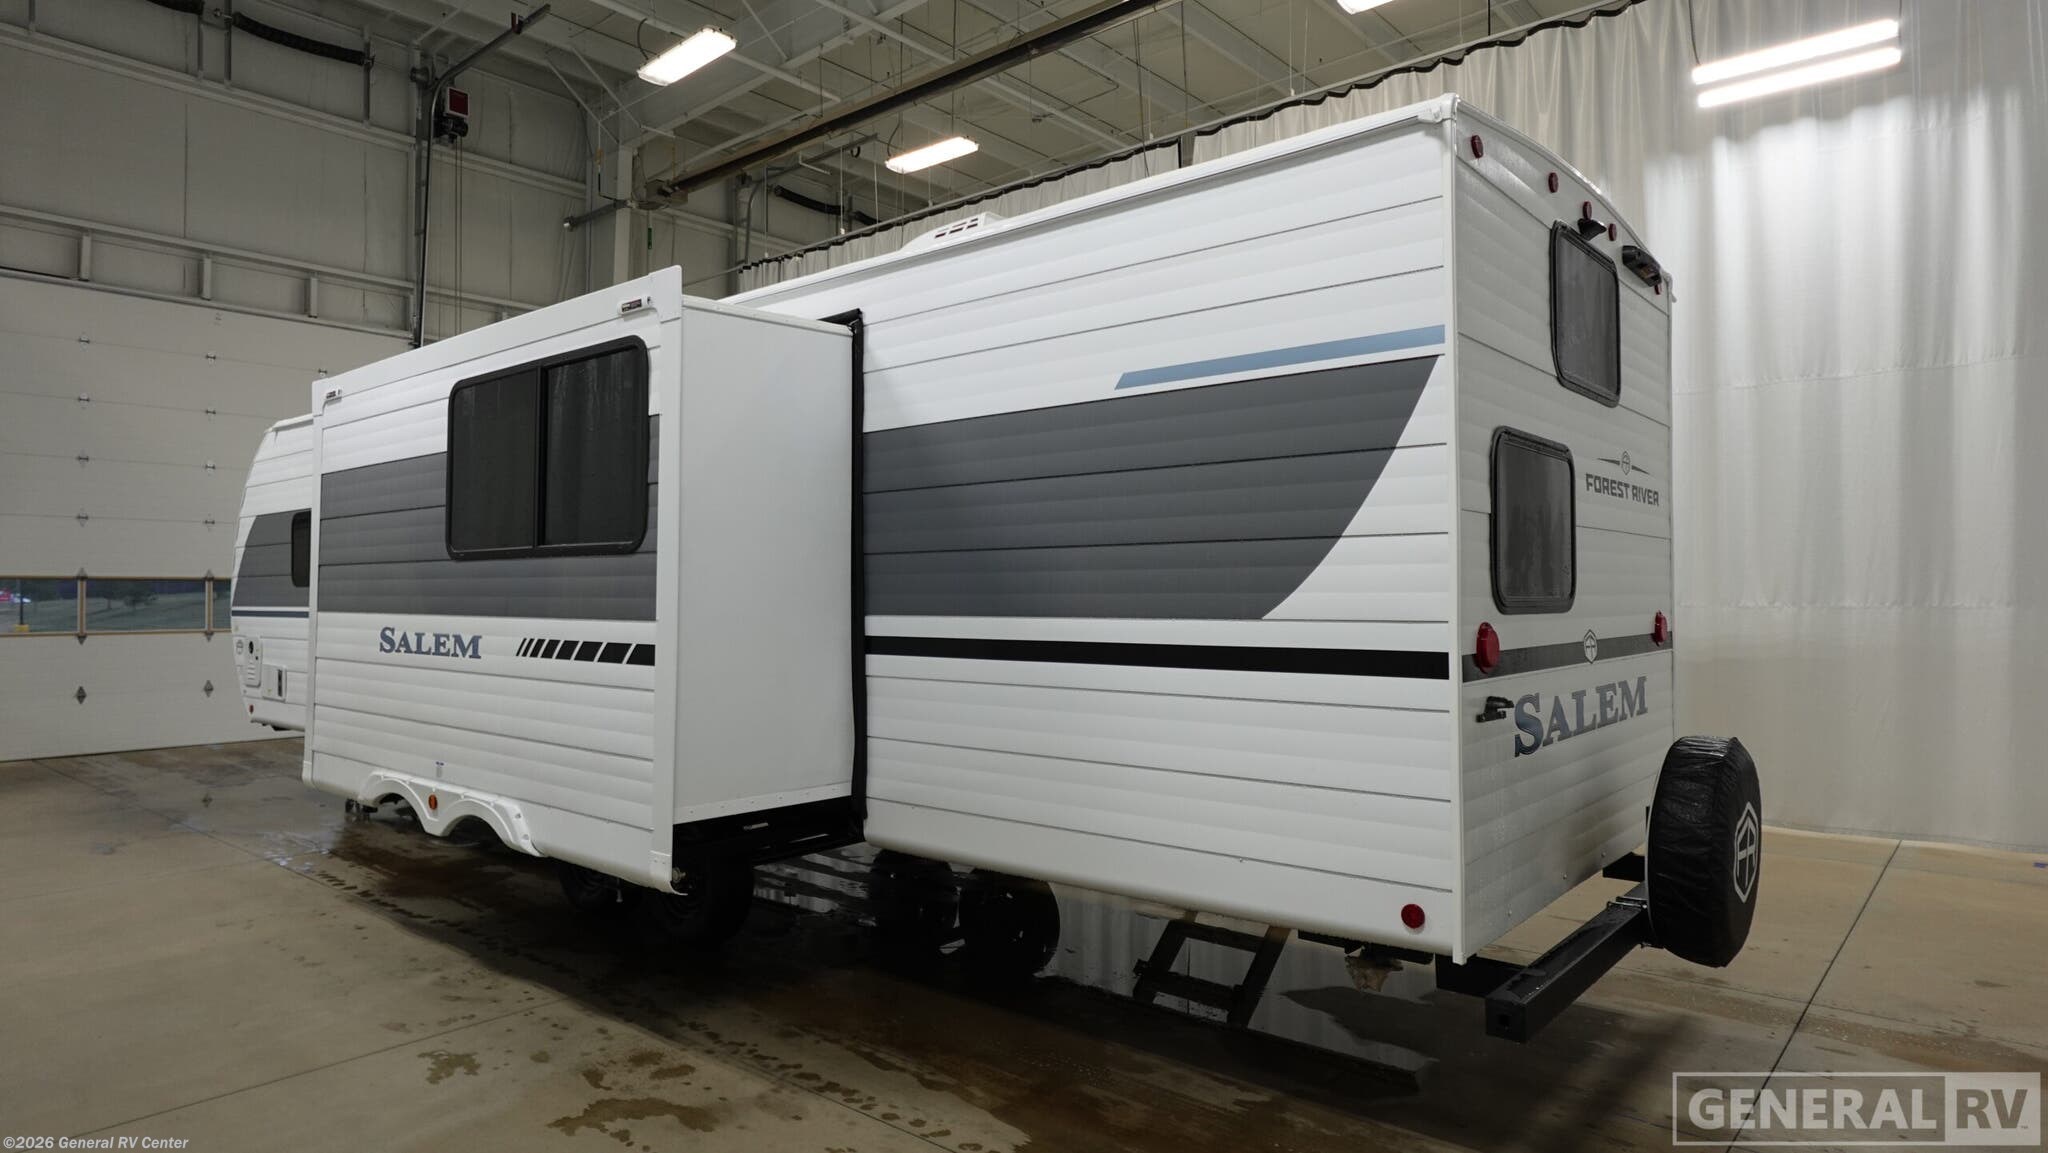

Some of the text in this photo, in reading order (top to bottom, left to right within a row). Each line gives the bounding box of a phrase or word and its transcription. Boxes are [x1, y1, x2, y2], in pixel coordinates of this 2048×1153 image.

[1586, 473, 1660, 506] FOREST RIVER
[379, 626, 482, 660] SALEM
[1514, 676, 1649, 758] SALEM
